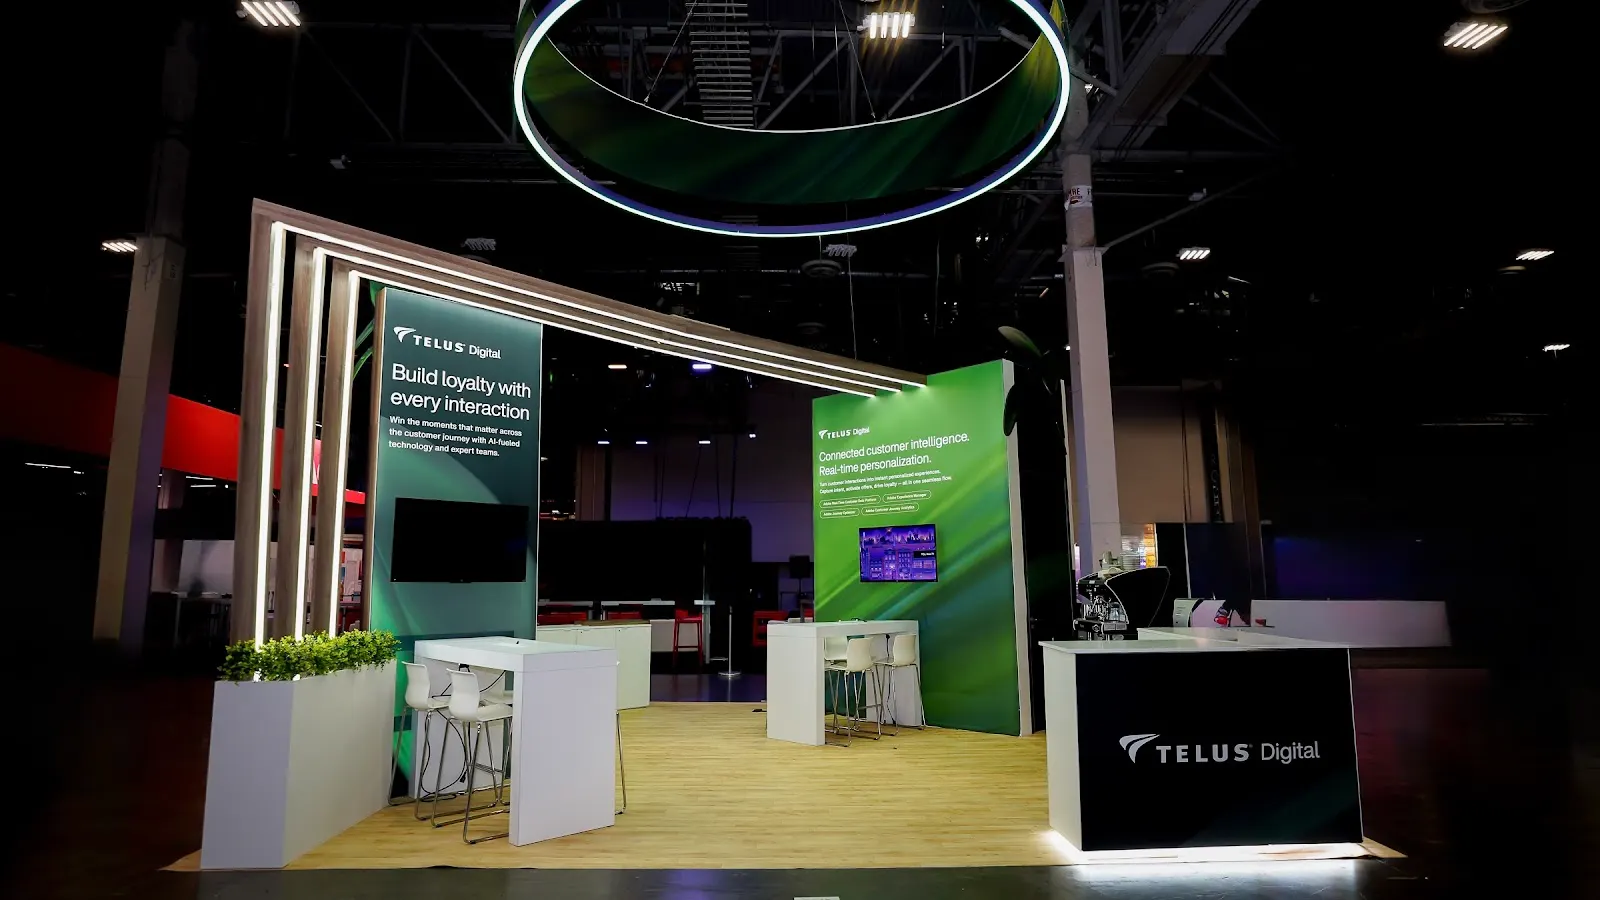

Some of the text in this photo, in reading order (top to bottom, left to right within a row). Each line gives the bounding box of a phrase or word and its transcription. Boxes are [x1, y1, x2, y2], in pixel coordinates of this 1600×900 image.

[413, 335, 501, 359] TELUS Digital
[392, 363, 531, 398] Build loyalty with
[390, 392, 530, 420] every interaction
[390, 416, 405, 424] Win
[407, 418, 420, 426] the
[422, 420, 457, 430] moments
[459, 423, 473, 431] that
[475, 425, 498, 434] matter
[827, 426, 870, 439] TELUS Digital
[388, 440, 500, 457] technology and expert teams.
[389, 428, 520, 447] the customer journey with AI-fueled
[819, 432, 970, 462] Connected customer intelligence.
[819, 454, 932, 476] Real-time personalization.
[889, 472, 915, 480] personalized
[1156, 741, 1320, 764] TELUS Digital
